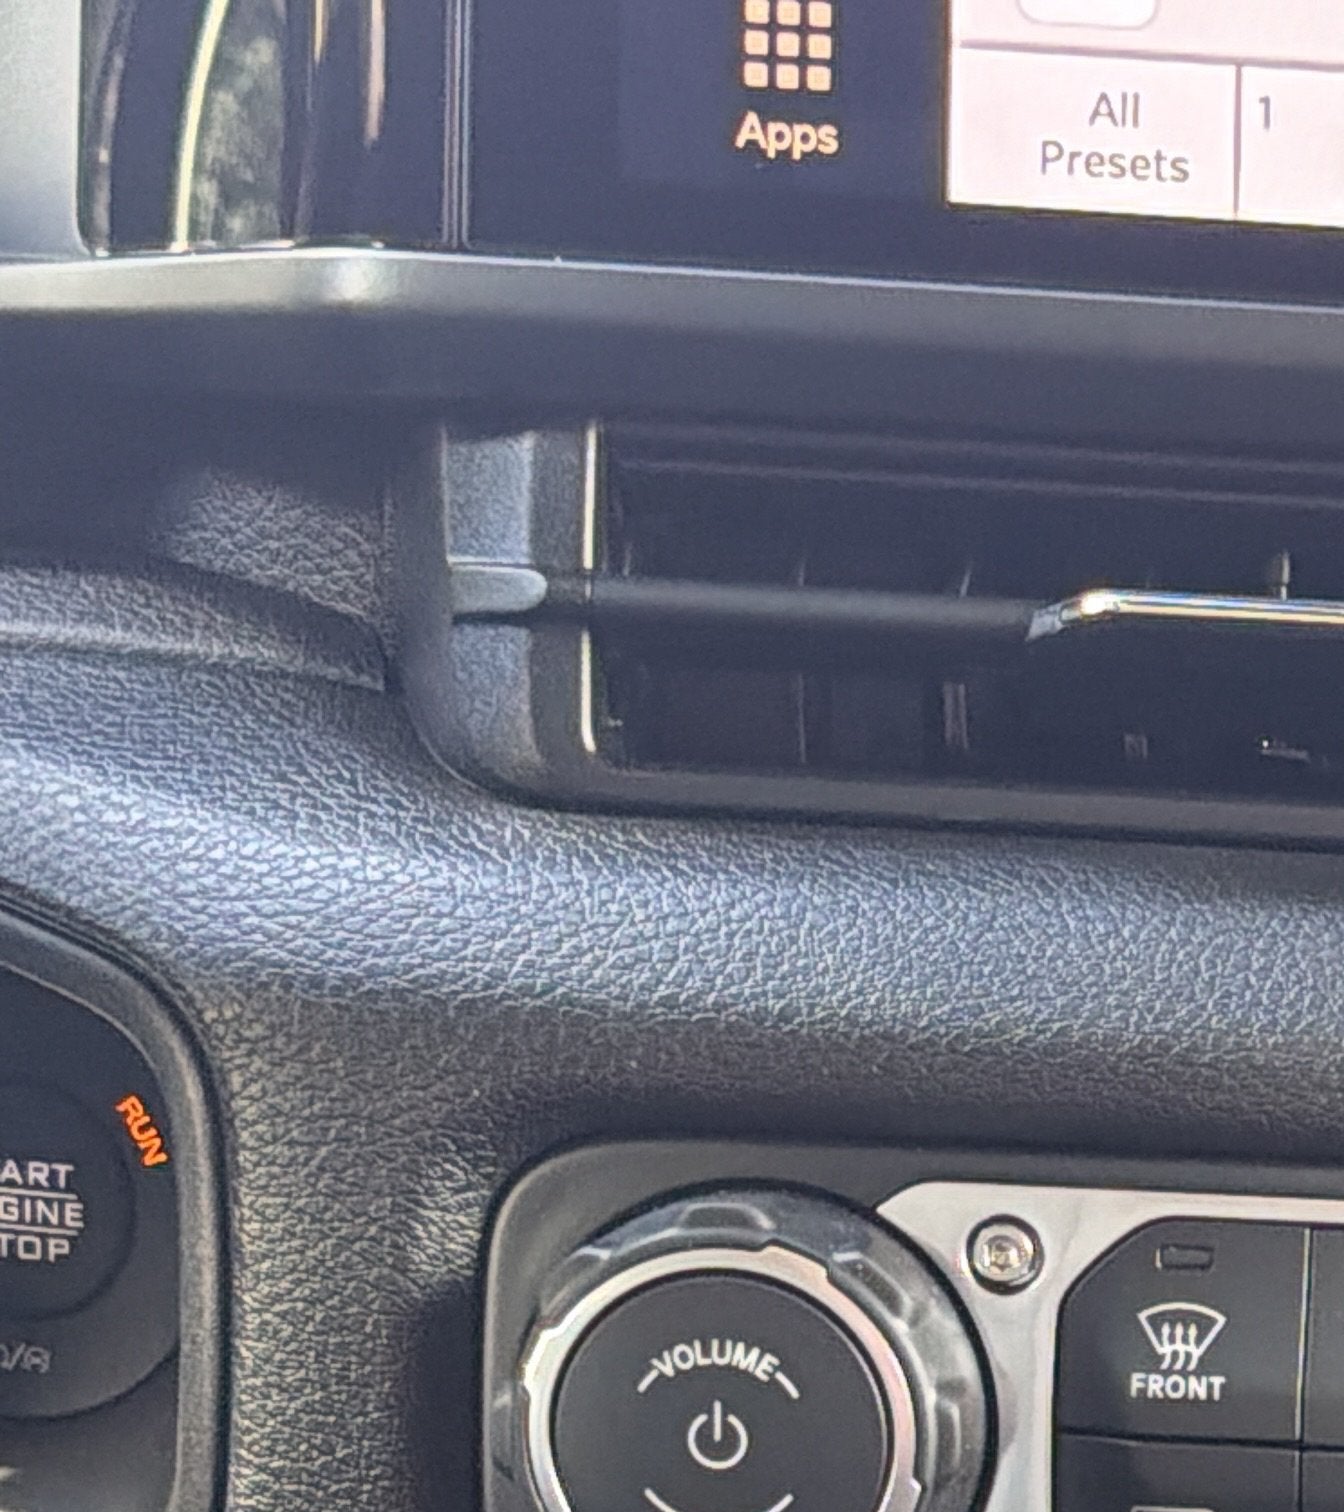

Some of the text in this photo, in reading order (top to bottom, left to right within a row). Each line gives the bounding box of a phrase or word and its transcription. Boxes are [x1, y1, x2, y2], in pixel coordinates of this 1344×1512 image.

[1088, 92, 1140, 129] All
[1260, 96, 1273, 130] 1
[735, 111, 840, 161] Apps
[1041, 141, 1190, 184] Presets
[115, 1096, 170, 1167] RUN
[0, 1158, 75, 1190] ART
[0, 1195, 85, 1229] GINE
[0, 1233, 70, 1263] TOP
[650, 1338, 781, 1383] VOLUME
[1130, 1374, 1226, 1401] FRONT
